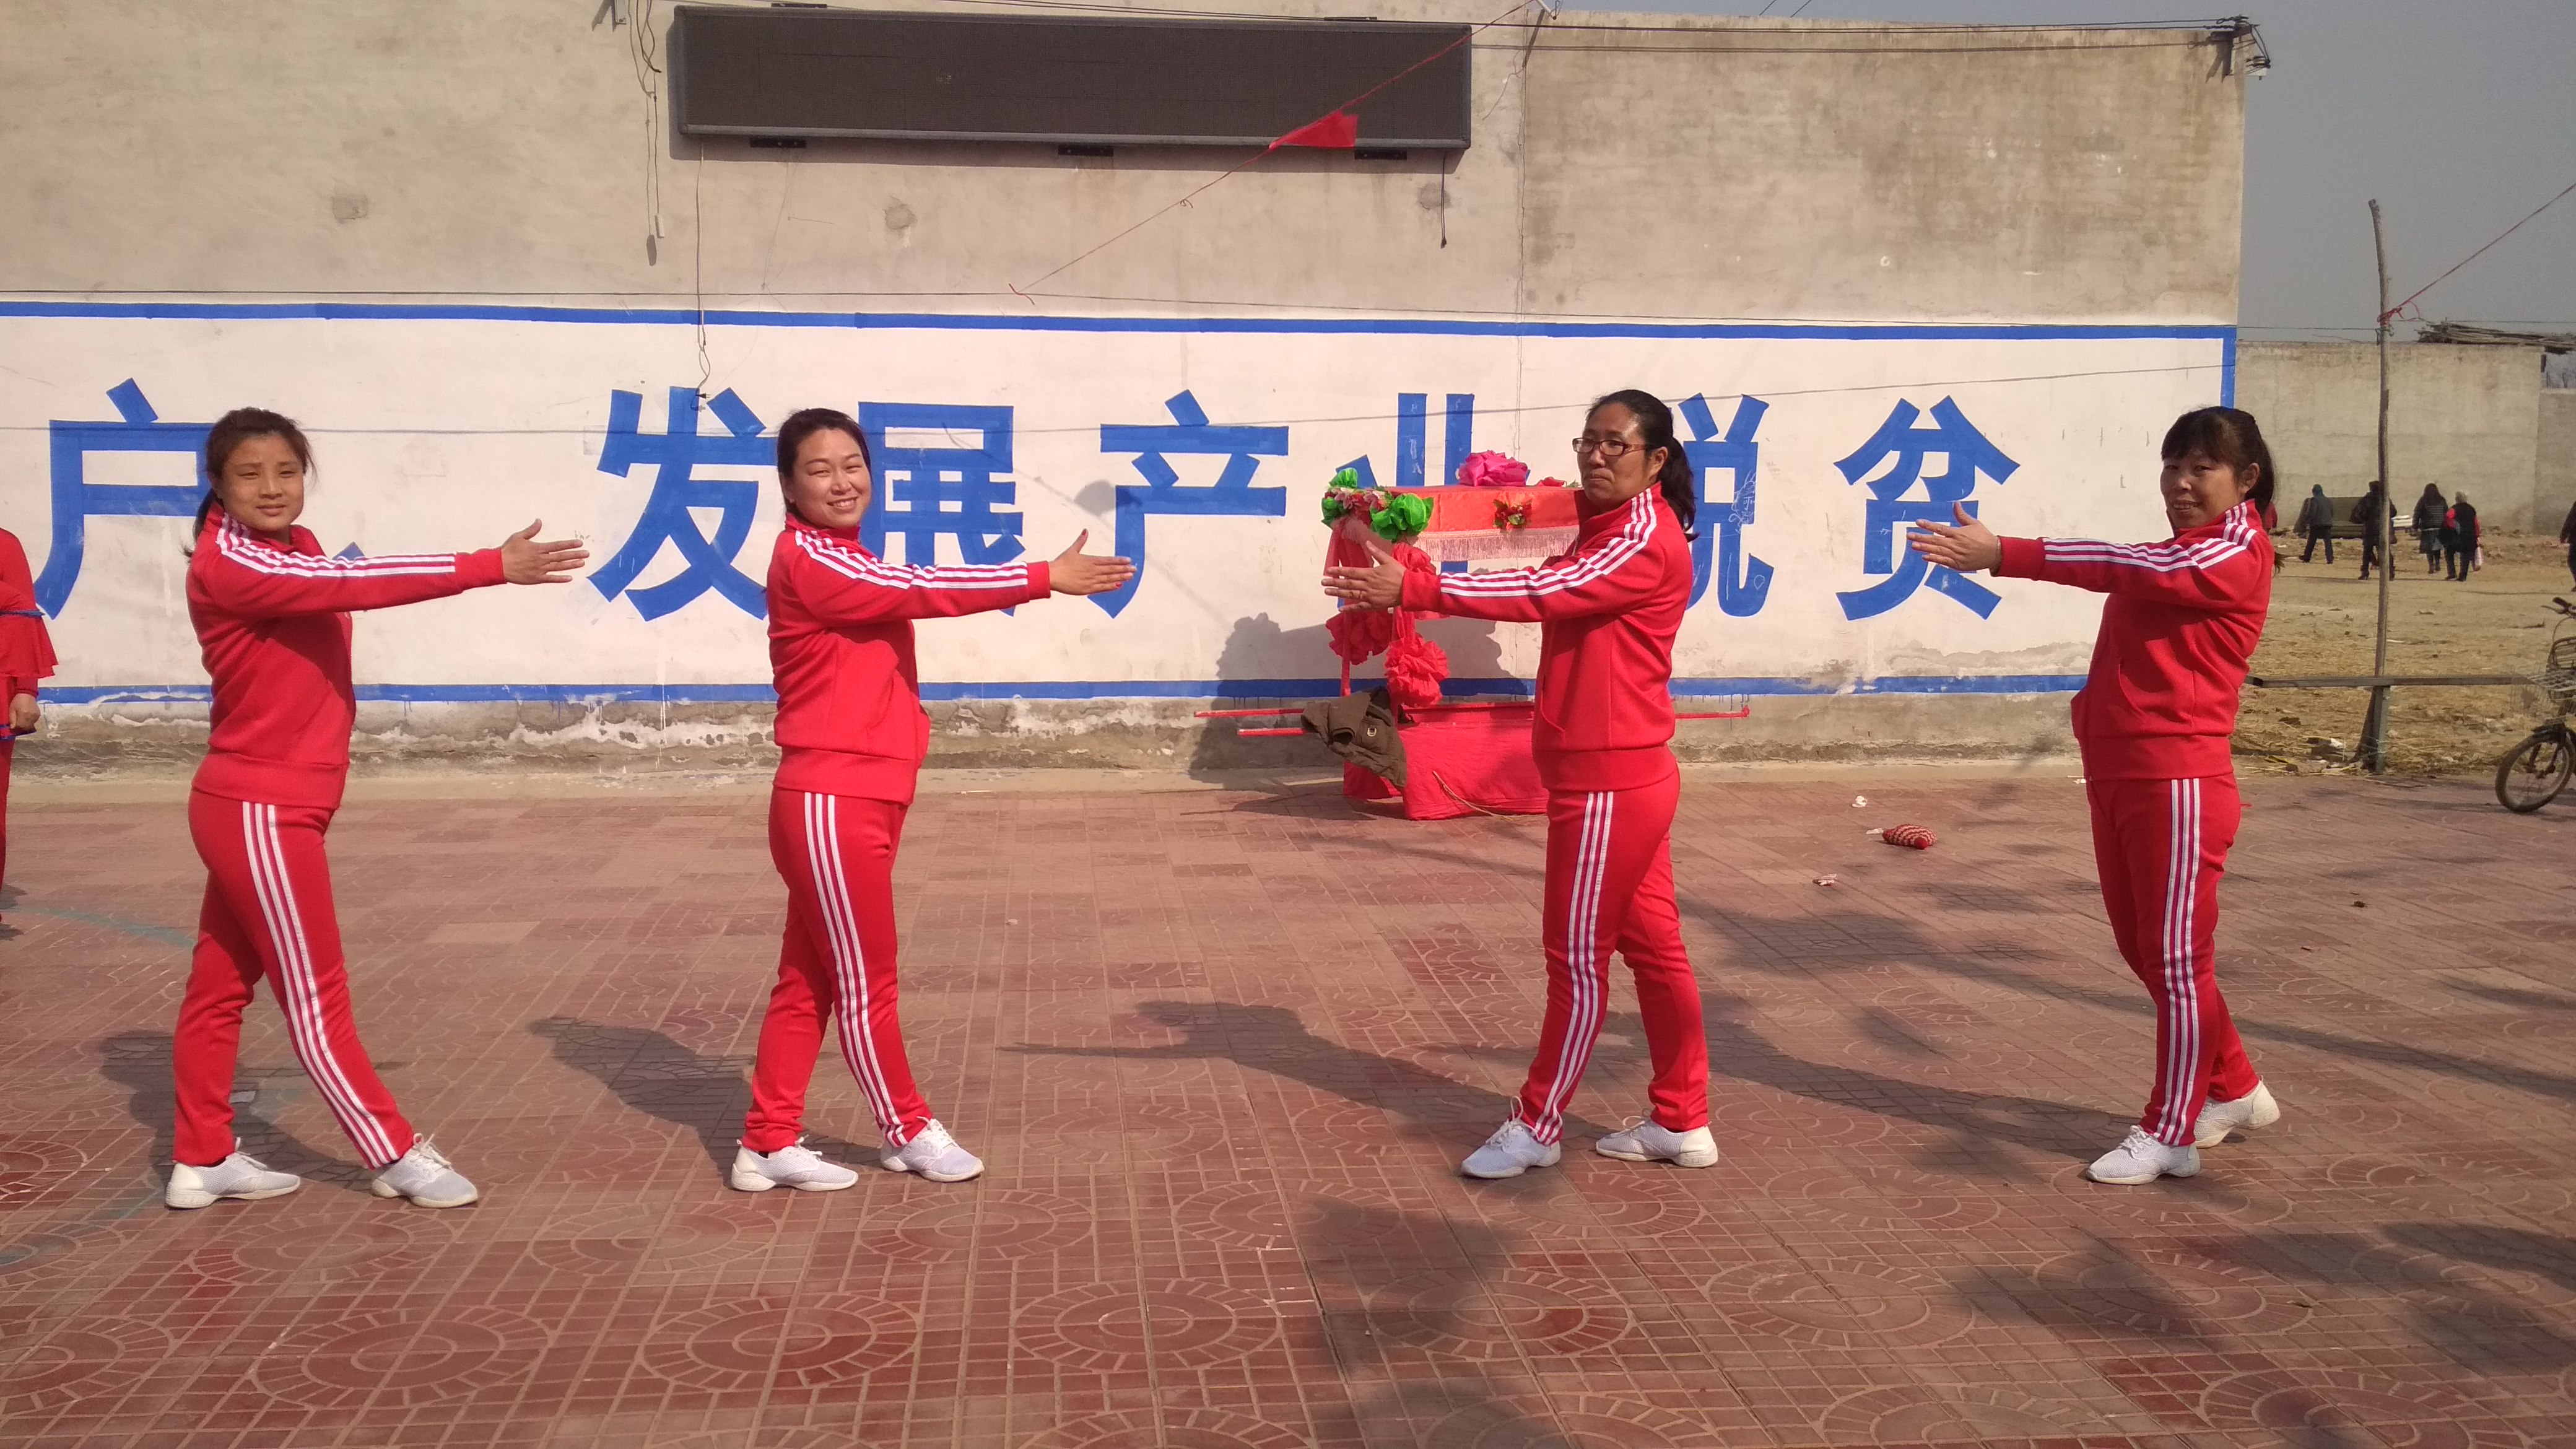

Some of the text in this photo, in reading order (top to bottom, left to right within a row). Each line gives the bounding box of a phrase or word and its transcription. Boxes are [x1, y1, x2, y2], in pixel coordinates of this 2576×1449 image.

[34, 378, 2021, 621] 户发展产脱贫
